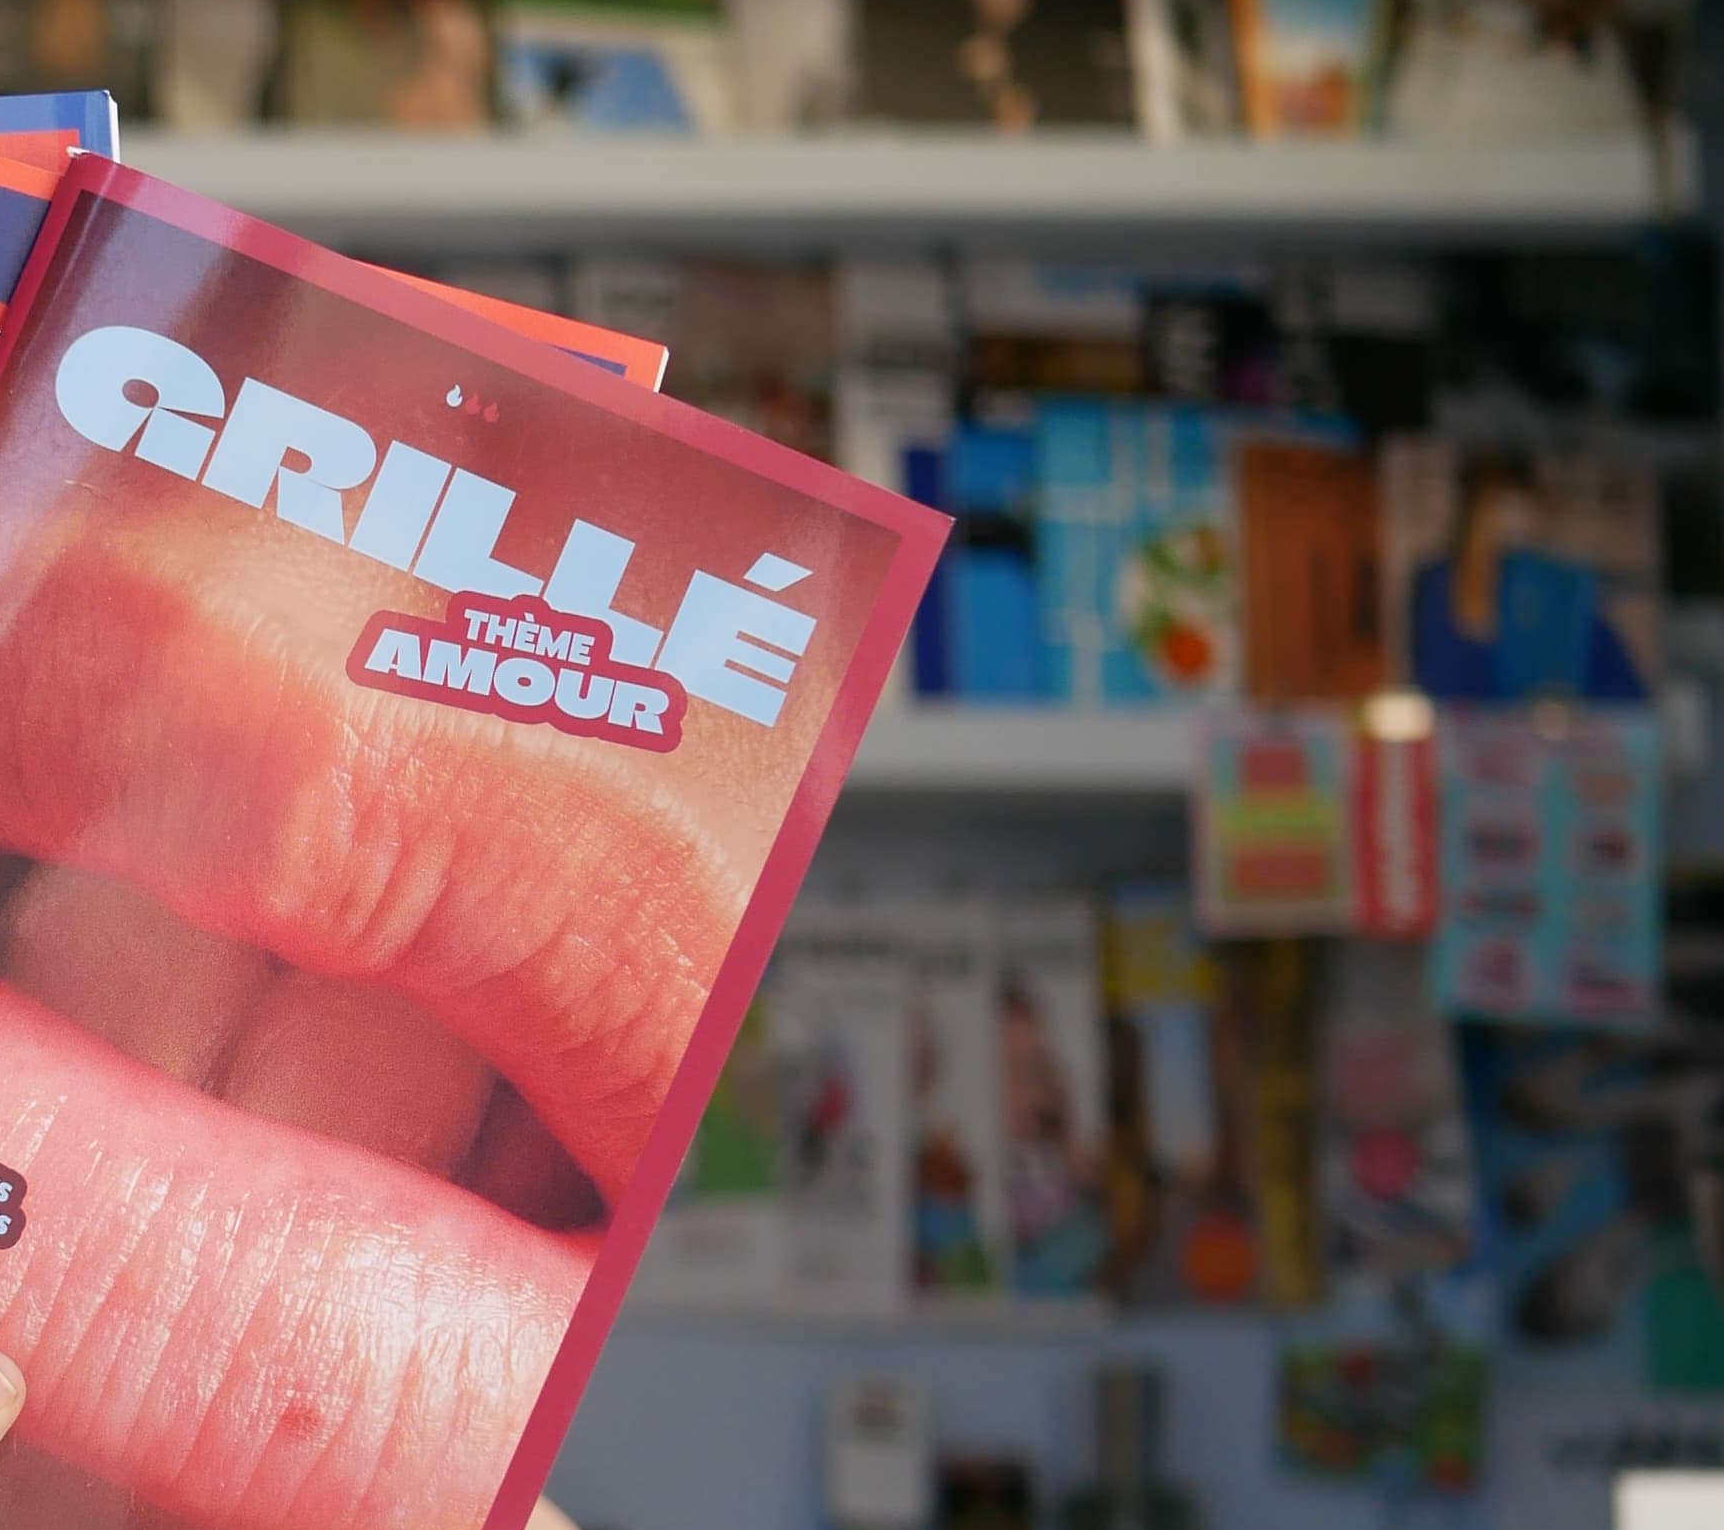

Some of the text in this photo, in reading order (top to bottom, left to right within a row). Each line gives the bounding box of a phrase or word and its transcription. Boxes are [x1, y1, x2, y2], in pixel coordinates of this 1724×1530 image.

[55, 324, 818, 728] GRILLÉ
[364, 627, 671, 735] AMOUR
[463, 608, 596, 666] THÈME
